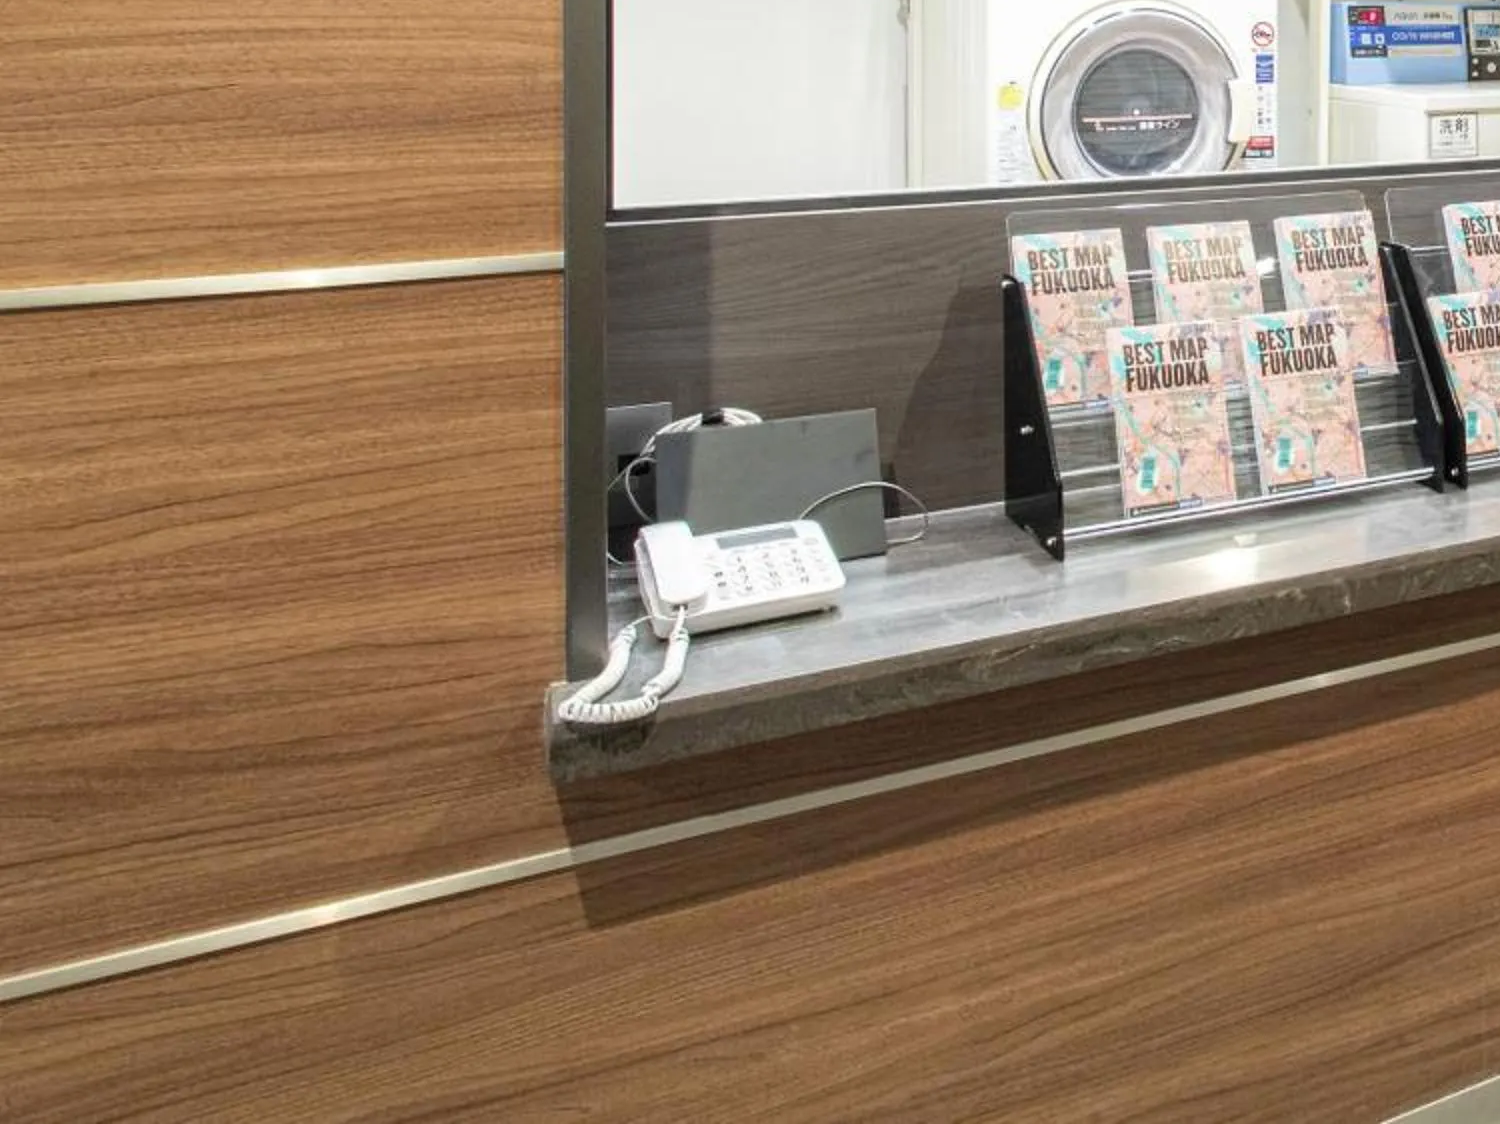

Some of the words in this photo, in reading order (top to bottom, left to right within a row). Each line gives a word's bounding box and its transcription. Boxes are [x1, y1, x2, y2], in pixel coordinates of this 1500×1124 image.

[1291, 228, 1329, 249] BEST
[1332, 226, 1366, 245] MAP
[1461, 215, 1493, 236] BEST
[1027, 250, 1070, 270] BEST
[1074, 247, 1113, 267] MAP
[1163, 238, 1203, 259] BEST
[1207, 236, 1243, 255] MAP
[1296, 247, 1369, 273] FUKUOKA
[1168, 258, 1246, 284] FUKUOKA
[1031, 272, 1116, 296] FUKUOKA
[1443, 307, 1478, 330] BEST
[1256, 327, 1296, 352] BEST
[1300, 323, 1335, 346] MAP
[1122, 341, 1165, 366] BEST
[1169, 337, 1209, 361] MAP
[1260, 346, 1338, 377] FUKUOKA
[1125, 364, 1210, 393] FUKUOKA
